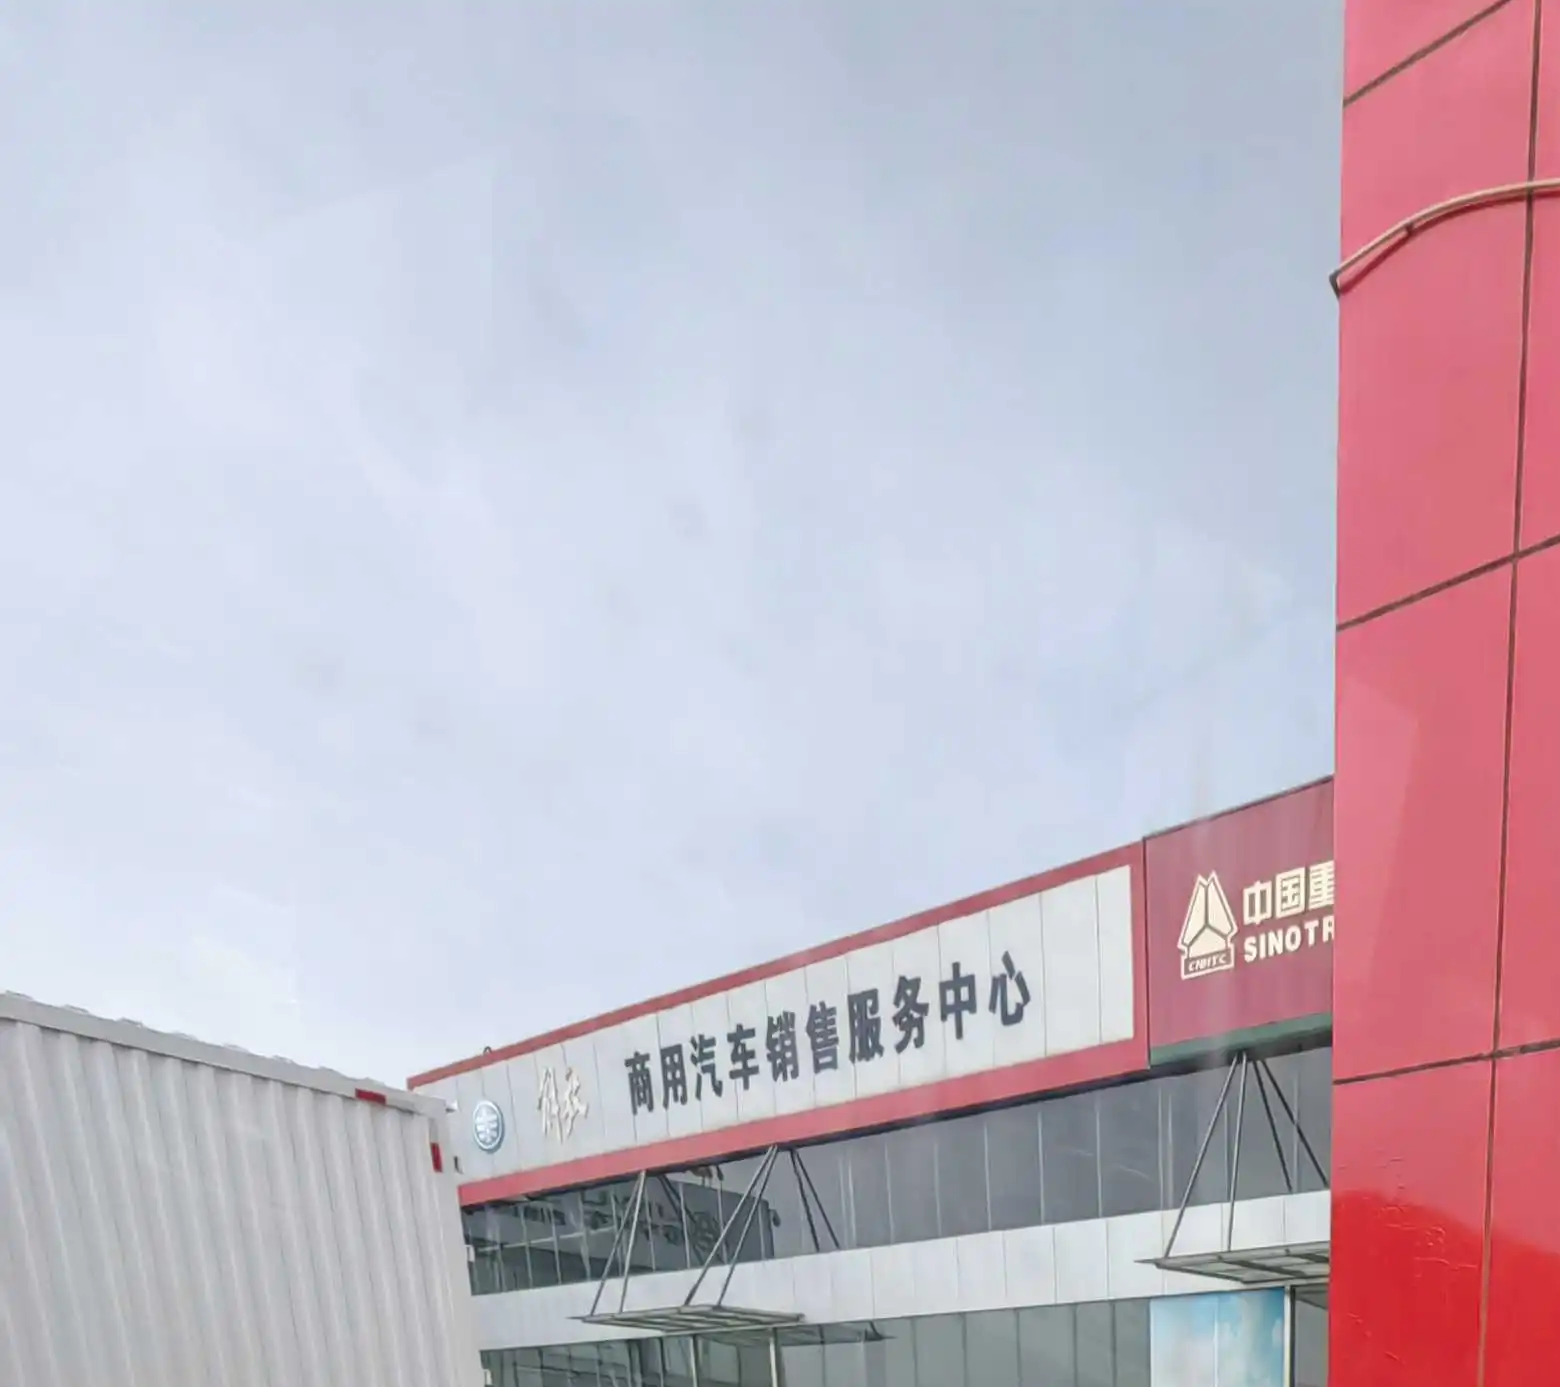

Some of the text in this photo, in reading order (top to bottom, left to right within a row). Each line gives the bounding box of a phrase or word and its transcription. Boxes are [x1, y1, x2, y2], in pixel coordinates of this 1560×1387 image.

[624, 950, 1031, 1116] 商用汽车销售服务中心
